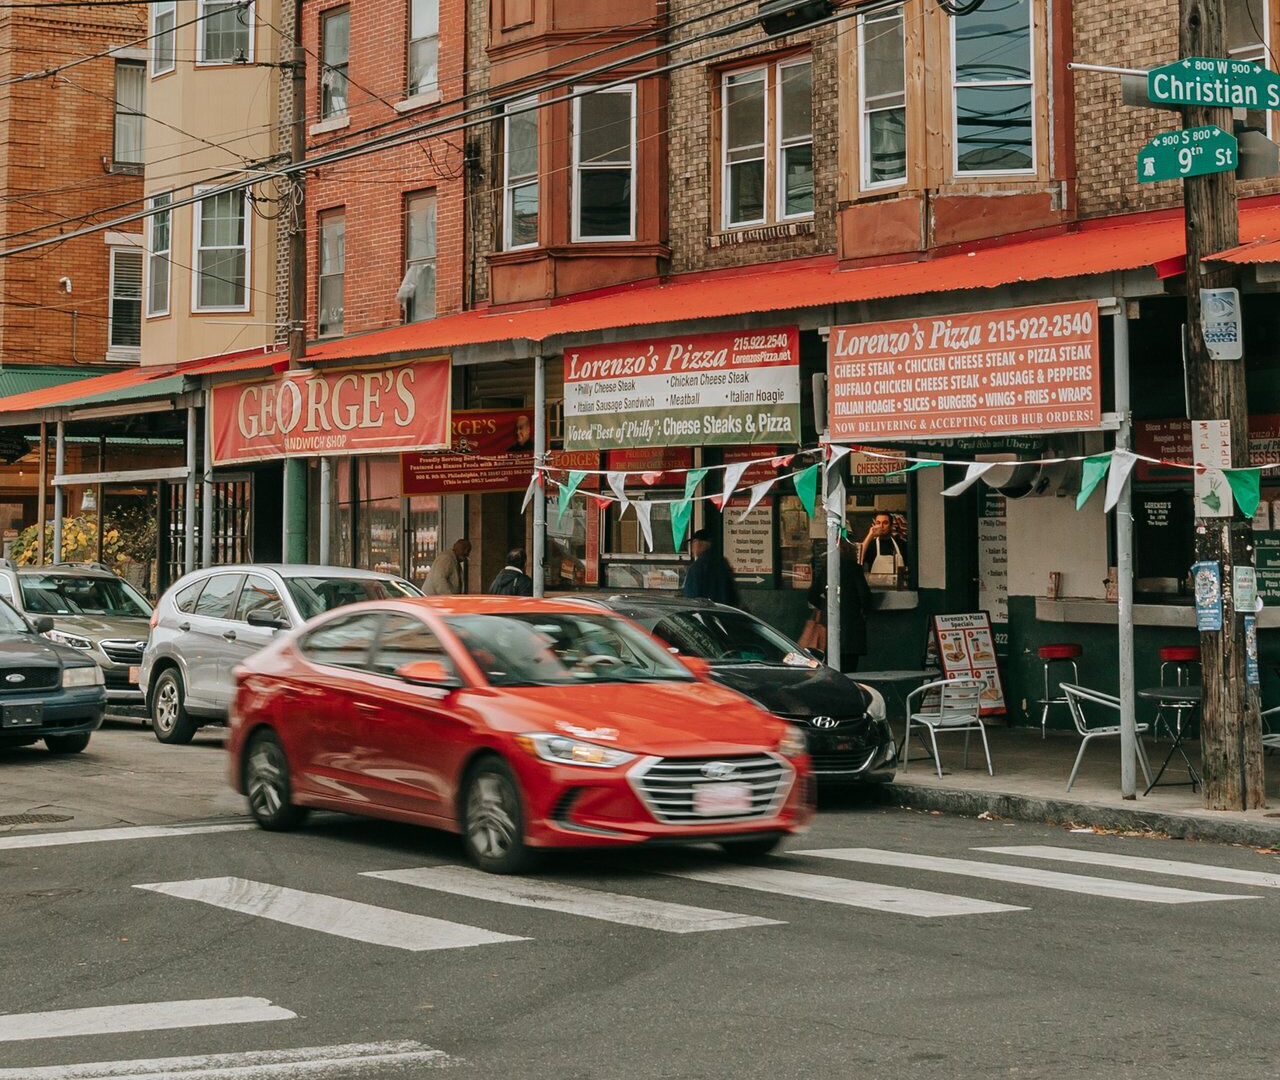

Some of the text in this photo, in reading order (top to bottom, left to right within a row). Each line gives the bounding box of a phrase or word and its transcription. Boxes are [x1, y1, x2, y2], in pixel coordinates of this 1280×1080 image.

[1195, 61, 1250, 74] 800 W 900
[1154, 74, 1257, 105] Christian
[1162, 129, 1210, 145] 900 S 800
[1178, 145, 1232, 174] 9th St
[835, 311, 1092, 357] Lorenzo's Pizza 215-922-2540
[568, 333, 788, 379] Lorenzo's Pizza 215.922.2540
[732, 348, 791, 364] LorenzosPizza.net
[834, 344, 1091, 378] CHEESE STEAK CHICKEN CHEESE STEAK PIZZA STEAK
[578, 371, 749, 396] Philly Cheese Steak Chicken Cheese Steak
[834, 365, 1092, 397] BUFFALO CHICKEN CHEESE STEAK SAUSAGE & PEPPERS
[238, 368, 416, 439] GEORGE'S
[577, 388, 784, 412] Italian Sausage Sandwich Meatball Italian Hoagie
[834, 386, 1092, 415] ITALIAN HOAGIE SLICES BURGERS WINGS FRIES WRAPS
[616, 420, 626, 443] of
[663, 416, 701, 436] Cheese
[703, 415, 742, 434] Steaks
[745, 413, 756, 433] &
[758, 412, 791, 432] Pizza
[835, 410, 1094, 434] NOW DELIVERING & ACCEPTING GRUB HUB ORDERS!
[326, 435, 346, 448] SHOP
